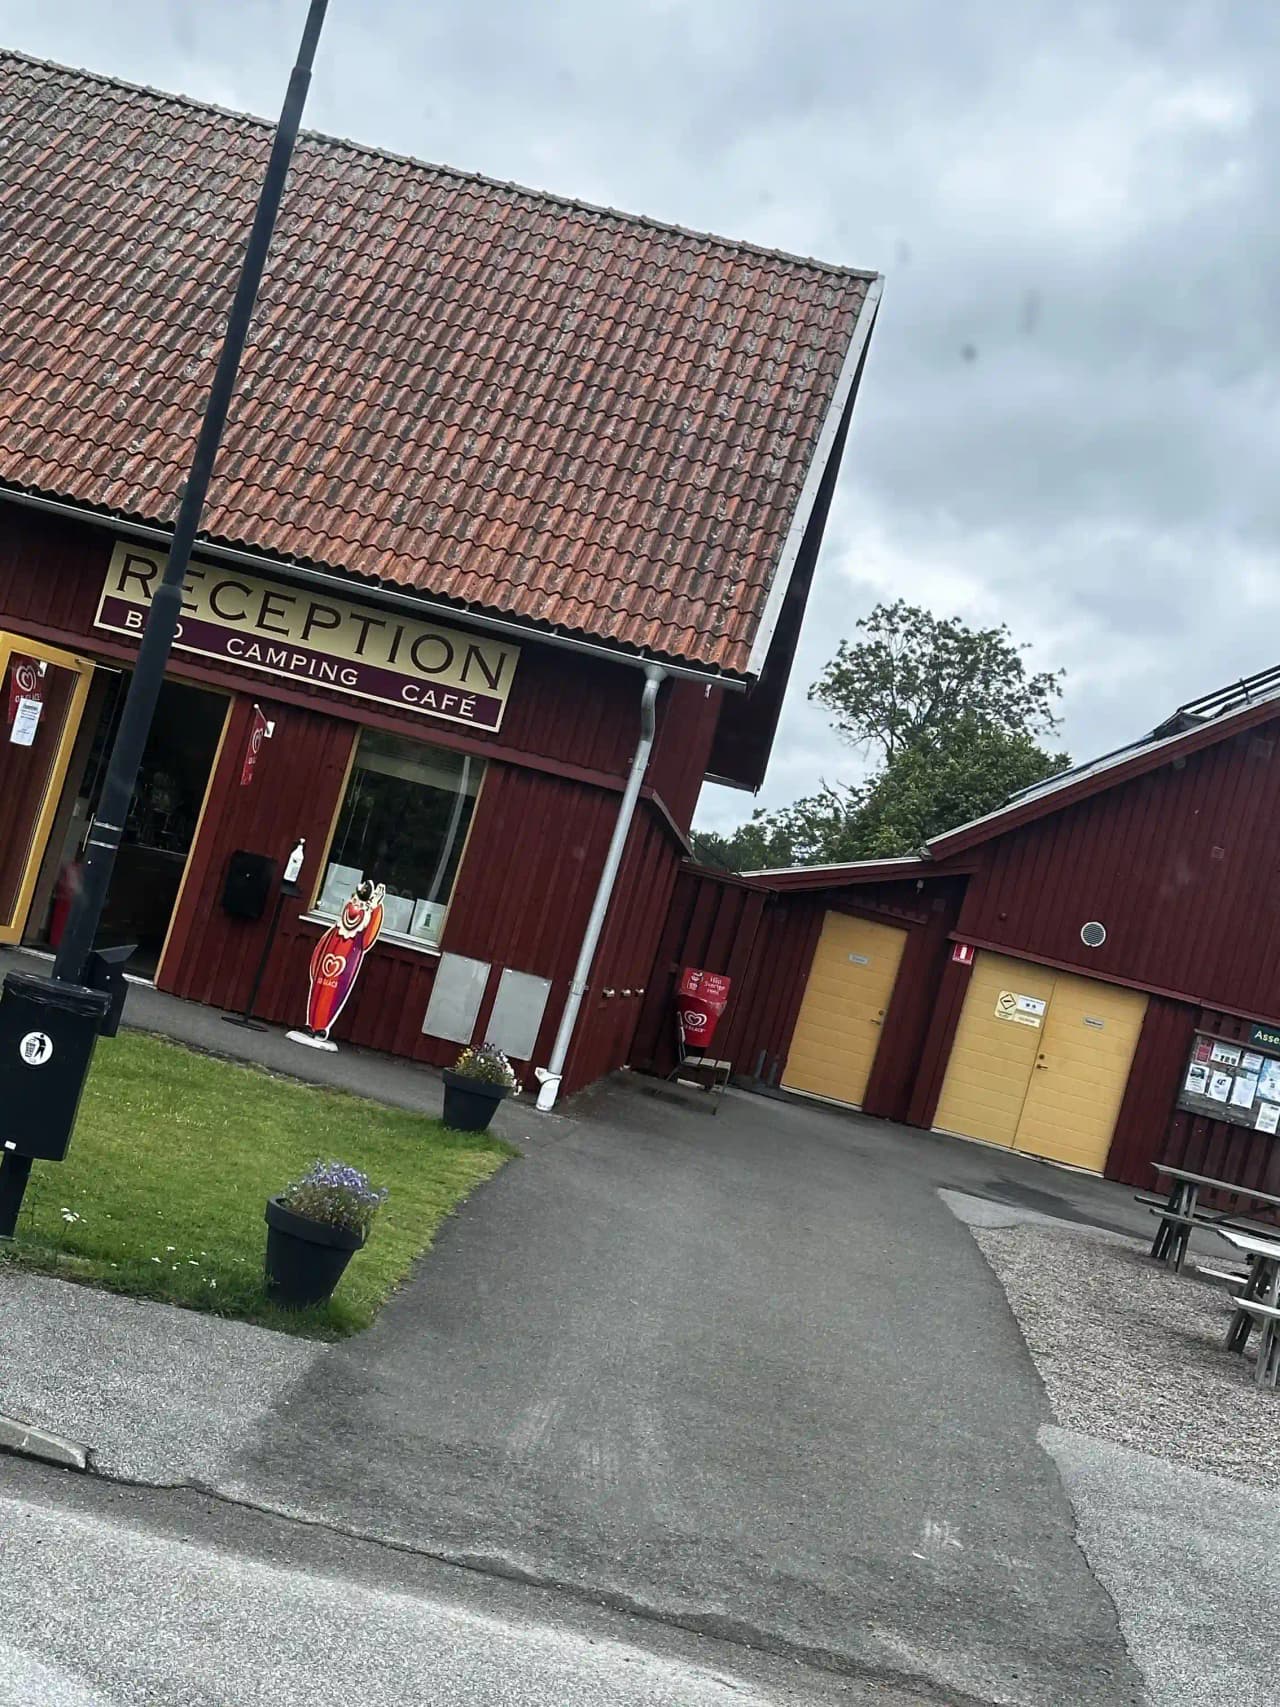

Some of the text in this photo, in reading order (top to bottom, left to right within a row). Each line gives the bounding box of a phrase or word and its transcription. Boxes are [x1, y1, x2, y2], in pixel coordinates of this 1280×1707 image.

[226, 638, 359, 686] CAMPING
[401, 684, 477, 718] CAFÉ
[1254, 1030, 1280, 1045] Asse
